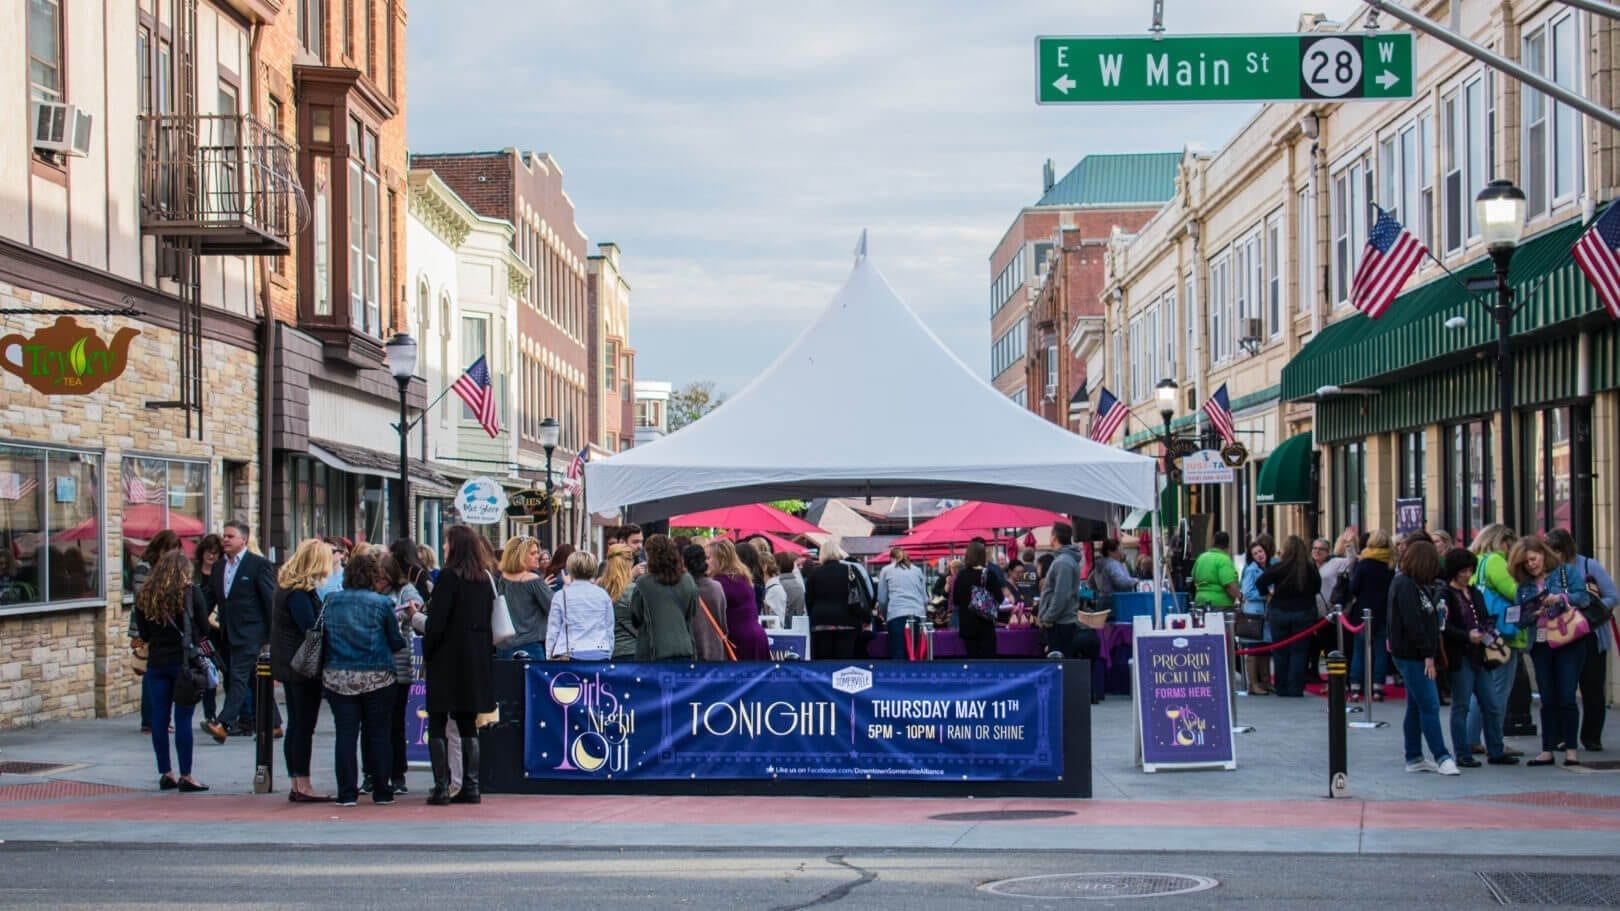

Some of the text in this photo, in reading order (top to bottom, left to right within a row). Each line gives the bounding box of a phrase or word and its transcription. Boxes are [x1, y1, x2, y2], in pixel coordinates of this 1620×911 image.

[1057, 46, 1070, 68] E
[1378, 42, 1395, 63] W
[1098, 52, 1270, 87] W Main St
[1310, 50, 1353, 84] 28
[63, 377, 83, 387] TEA
[1152, 652, 1210, 670] PRIORITY
[1193, 670, 1211, 683] LINE
[551, 672, 618, 722] Girls
[1155, 686, 1212, 698] FORMS HERE
[689, 699, 836, 739] TONIGHT!
[871, 699, 1019, 720] THURSDAY MAY 11TH
[868, 724, 893, 740] 5PM
[905, 724, 936, 740] 10PM
[947, 725, 1025, 740] RAIN OR SHINE
[775, 766, 788, 774] Like
